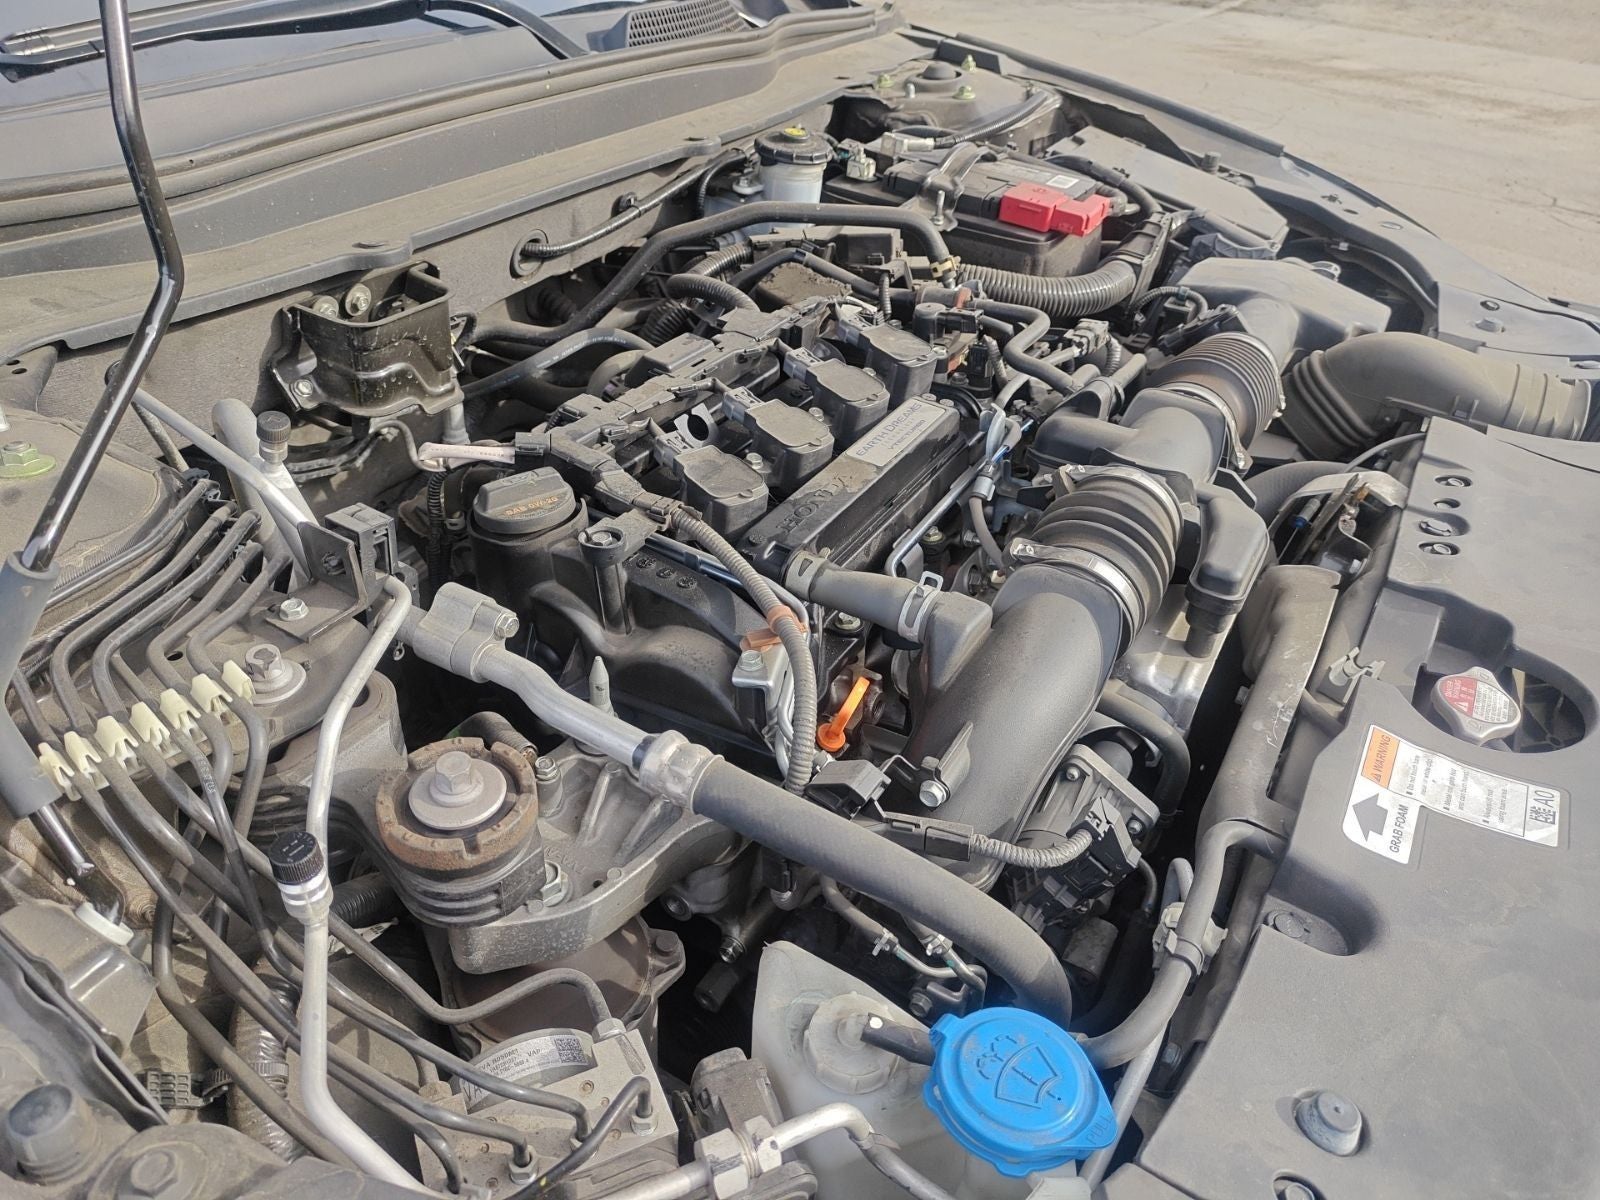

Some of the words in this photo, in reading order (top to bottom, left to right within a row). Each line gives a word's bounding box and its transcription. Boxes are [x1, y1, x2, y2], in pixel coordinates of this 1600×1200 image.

[856, 431, 887, 457] EARTH
[1372, 734, 1391, 774] WARNING
[1395, 804, 1409, 828] FOAM
[1389, 828, 1404, 853] GRAB
